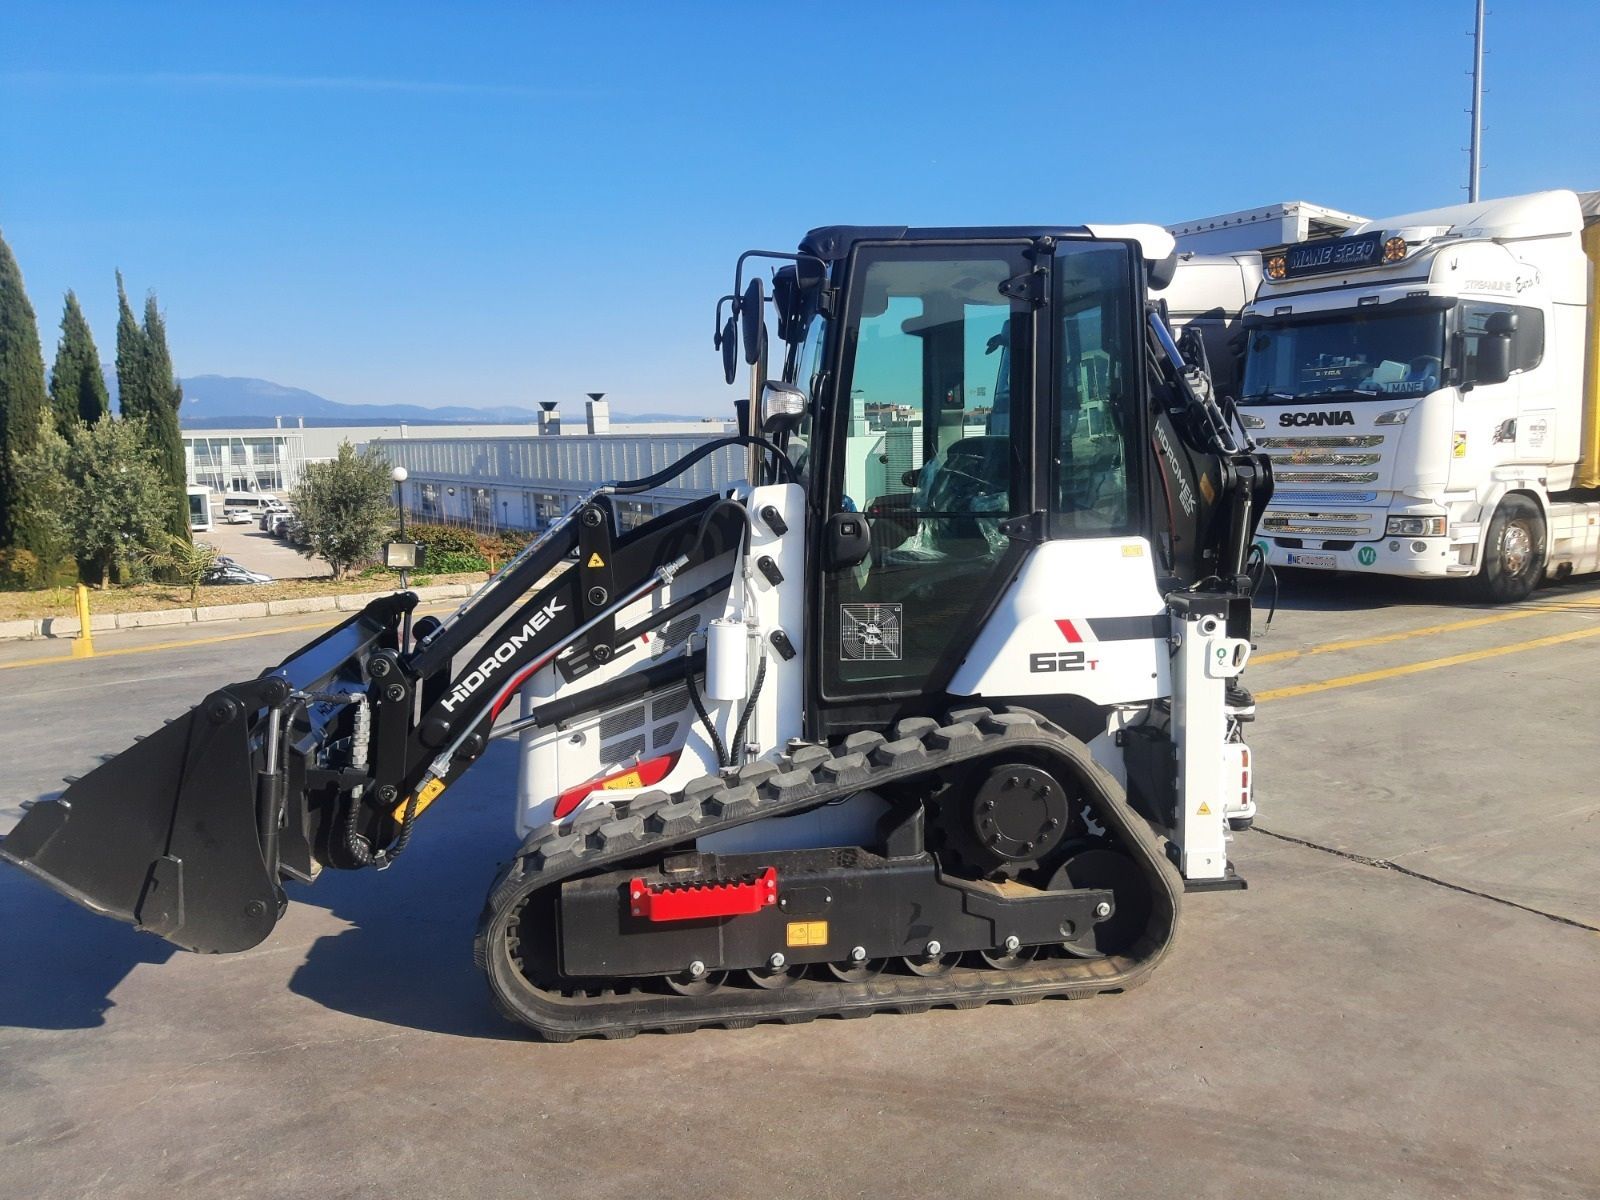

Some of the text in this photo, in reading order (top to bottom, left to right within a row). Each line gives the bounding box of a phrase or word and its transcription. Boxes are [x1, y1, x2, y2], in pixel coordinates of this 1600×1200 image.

[1291, 247, 1334, 269] MANE
[1391, 382, 1422, 393] MANE
[1279, 411, 1355, 427] SCANIA
